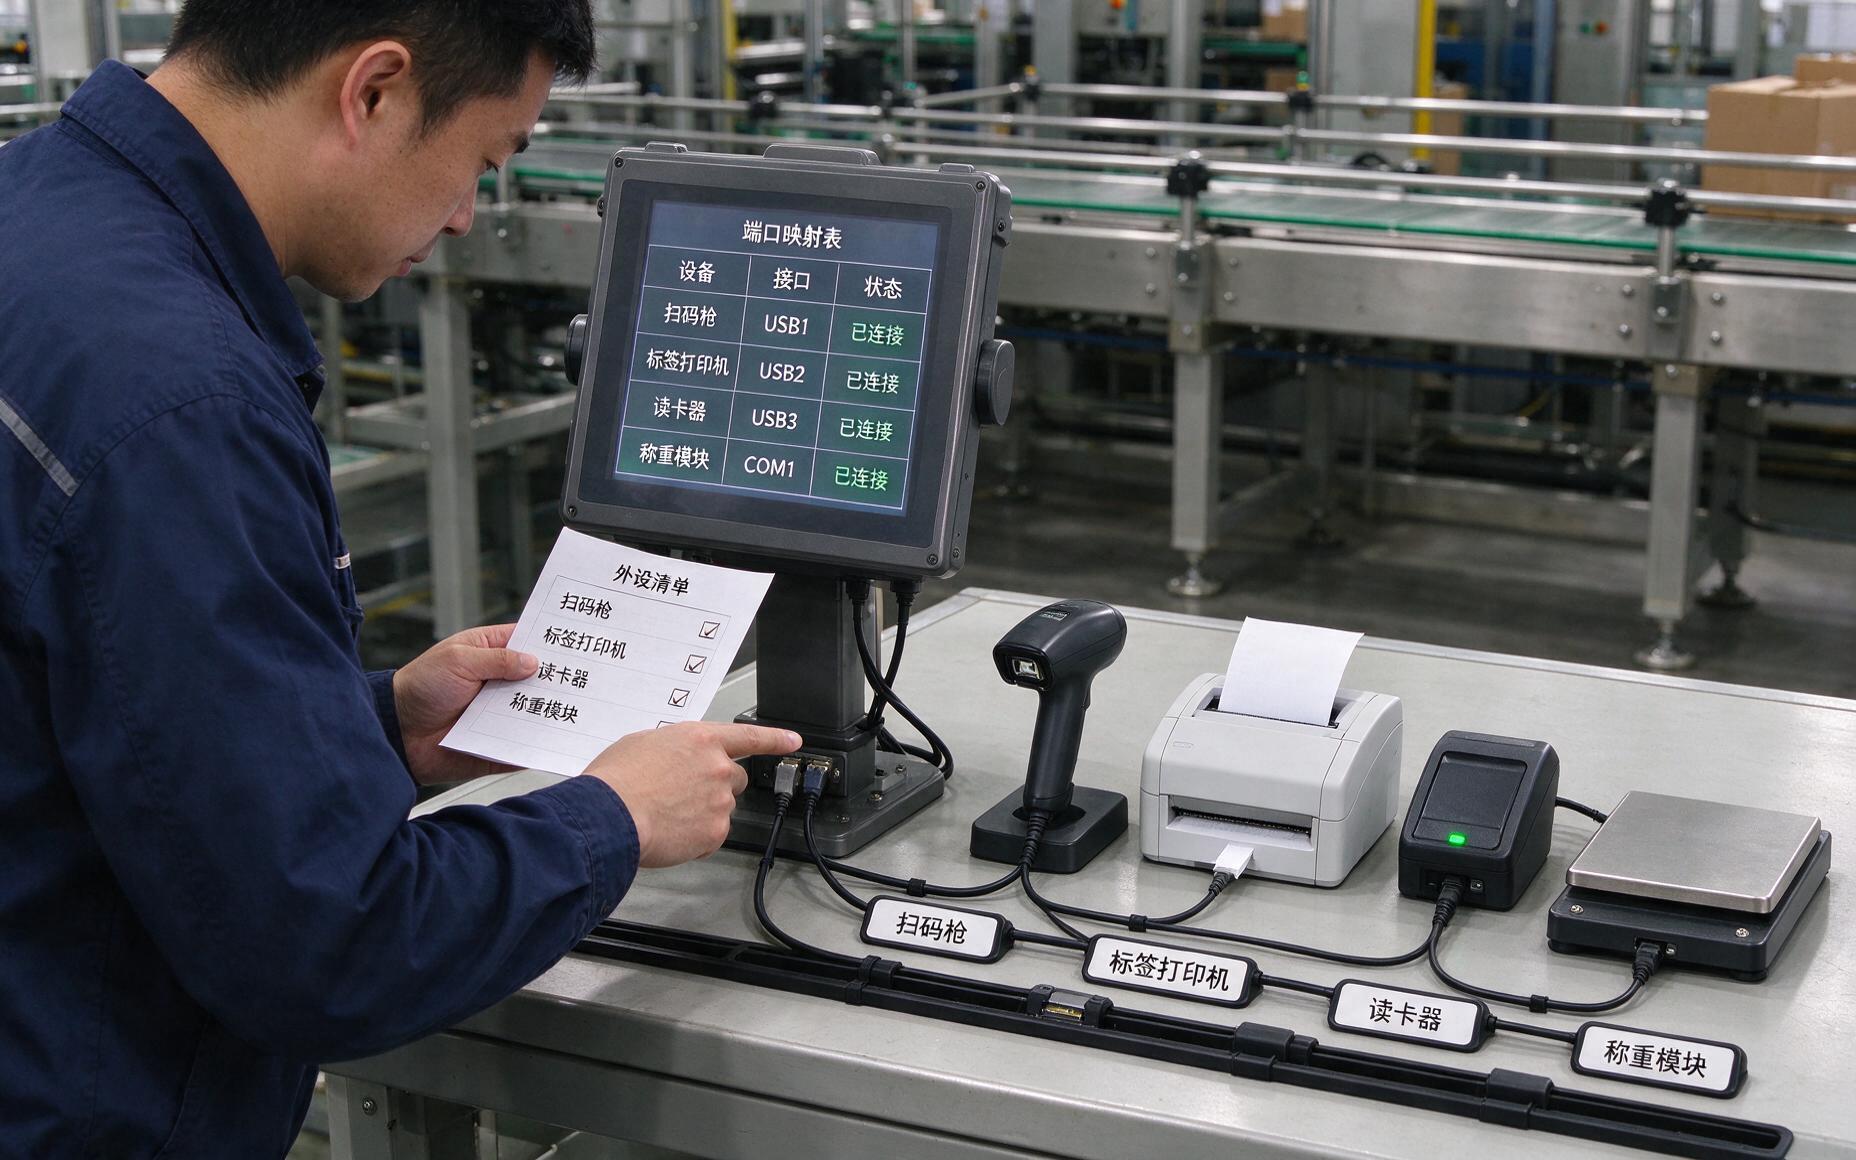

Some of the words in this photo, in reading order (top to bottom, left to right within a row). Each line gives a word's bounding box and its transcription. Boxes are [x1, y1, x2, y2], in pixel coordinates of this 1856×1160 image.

[742, 219, 842, 250] 端口映射表
[678, 260, 716, 283] 设备
[773, 267, 811, 291] 接口
[864, 276, 903, 299] 状态
[664, 303, 717, 328] 扫码枪
[764, 315, 809, 335] USB1
[852, 322, 904, 346] 已连接
[646, 348, 730, 377] 标签打印机
[759, 362, 805, 383] USB2
[846, 370, 900, 394] 已连接
[653, 396, 706, 423] 读卡器
[751, 410, 798, 430] USB3
[840, 417, 893, 442] 已连接
[639, 443, 710, 470] 称重模块
[744, 456, 794, 477] COM1
[835, 465, 889, 491] 已连接
[613, 564, 690, 596] 外设清单
[559, 592, 613, 620] 扫码枪
[543, 625, 627, 660] 标签打印机
[537, 661, 589, 689] 读卡器
[509, 692, 579, 724] 称重模块
[896, 911, 968, 945] 扫码枪
[1109, 949, 1229, 992] 标签打印机
[1368, 997, 1442, 1033] 读卡器
[1604, 1040, 1707, 1079] 称重模块
